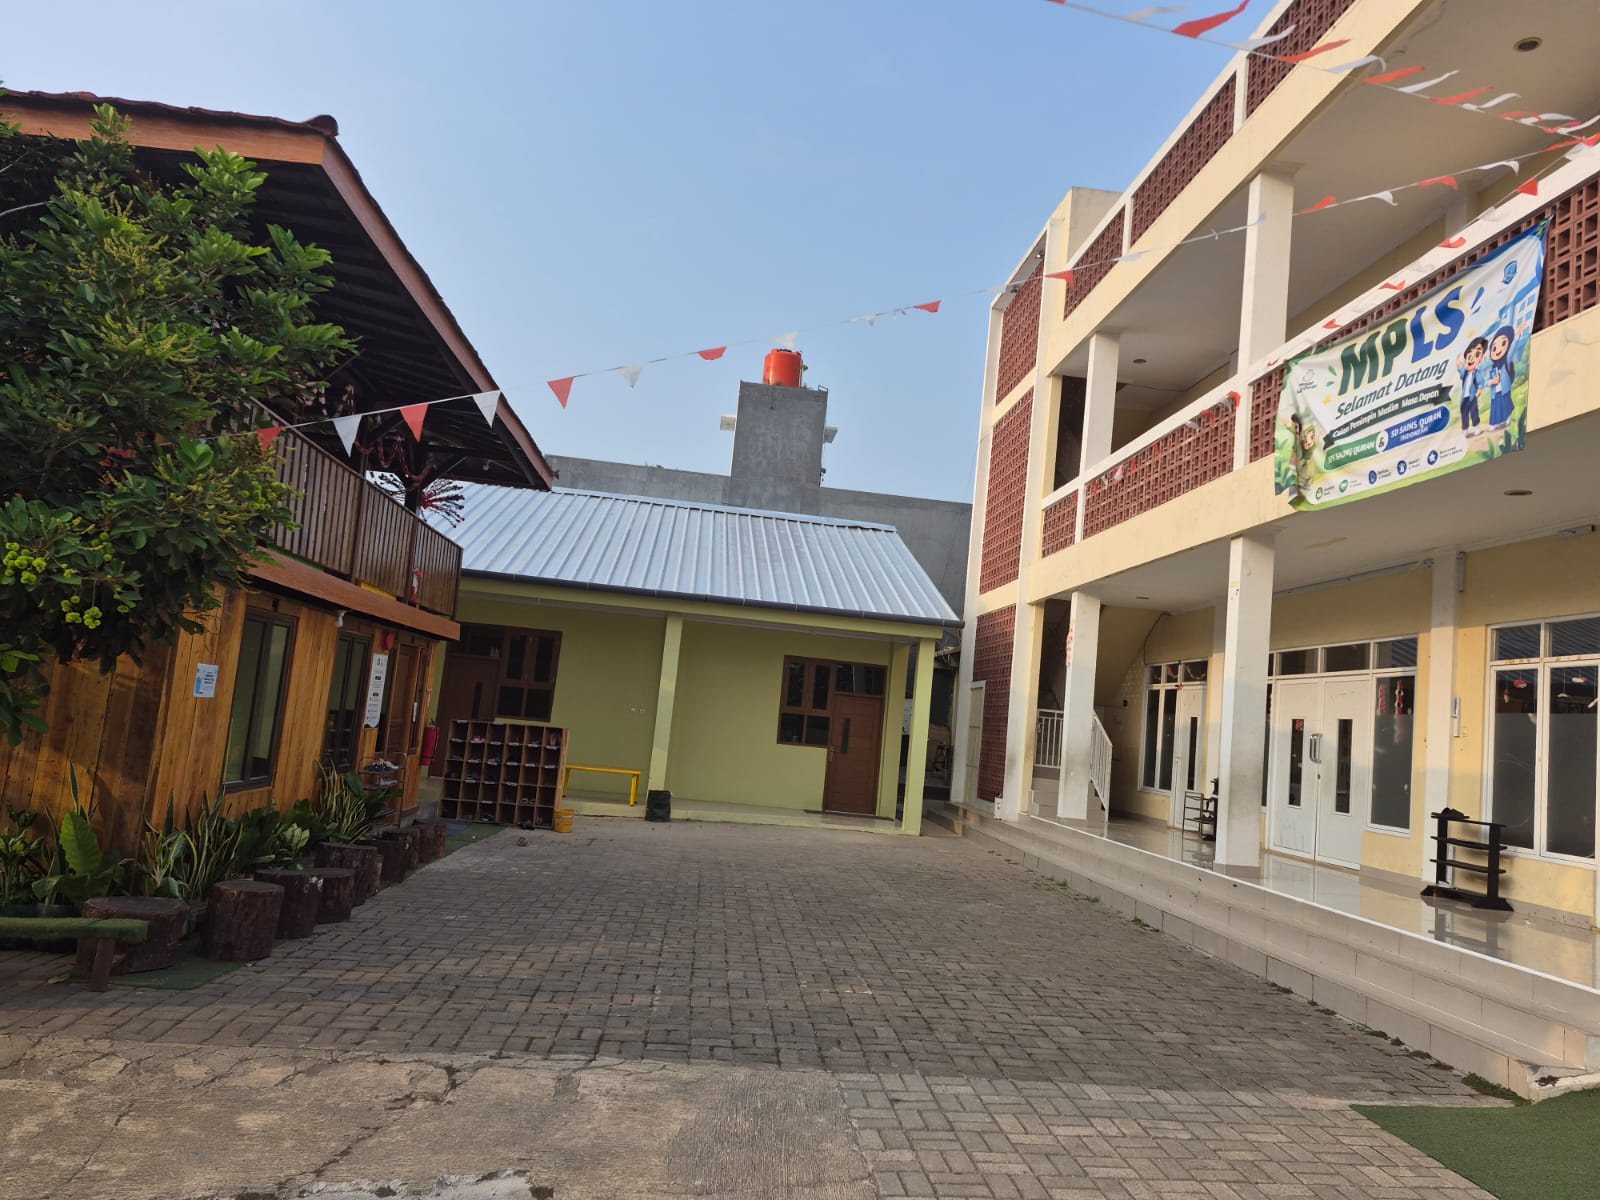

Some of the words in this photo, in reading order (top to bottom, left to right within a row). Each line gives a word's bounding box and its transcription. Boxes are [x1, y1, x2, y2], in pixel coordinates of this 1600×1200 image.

[1338, 286, 1466, 396] MPLS
[1335, 381, 1392, 419] Selamat
[1394, 360, 1449, 392] Datang
[1419, 390, 1440, 402] Depan
[1391, 428, 1399, 438] SD
[1399, 420, 1418, 434] SAINS
[1419, 410, 1442, 428] QURAN
